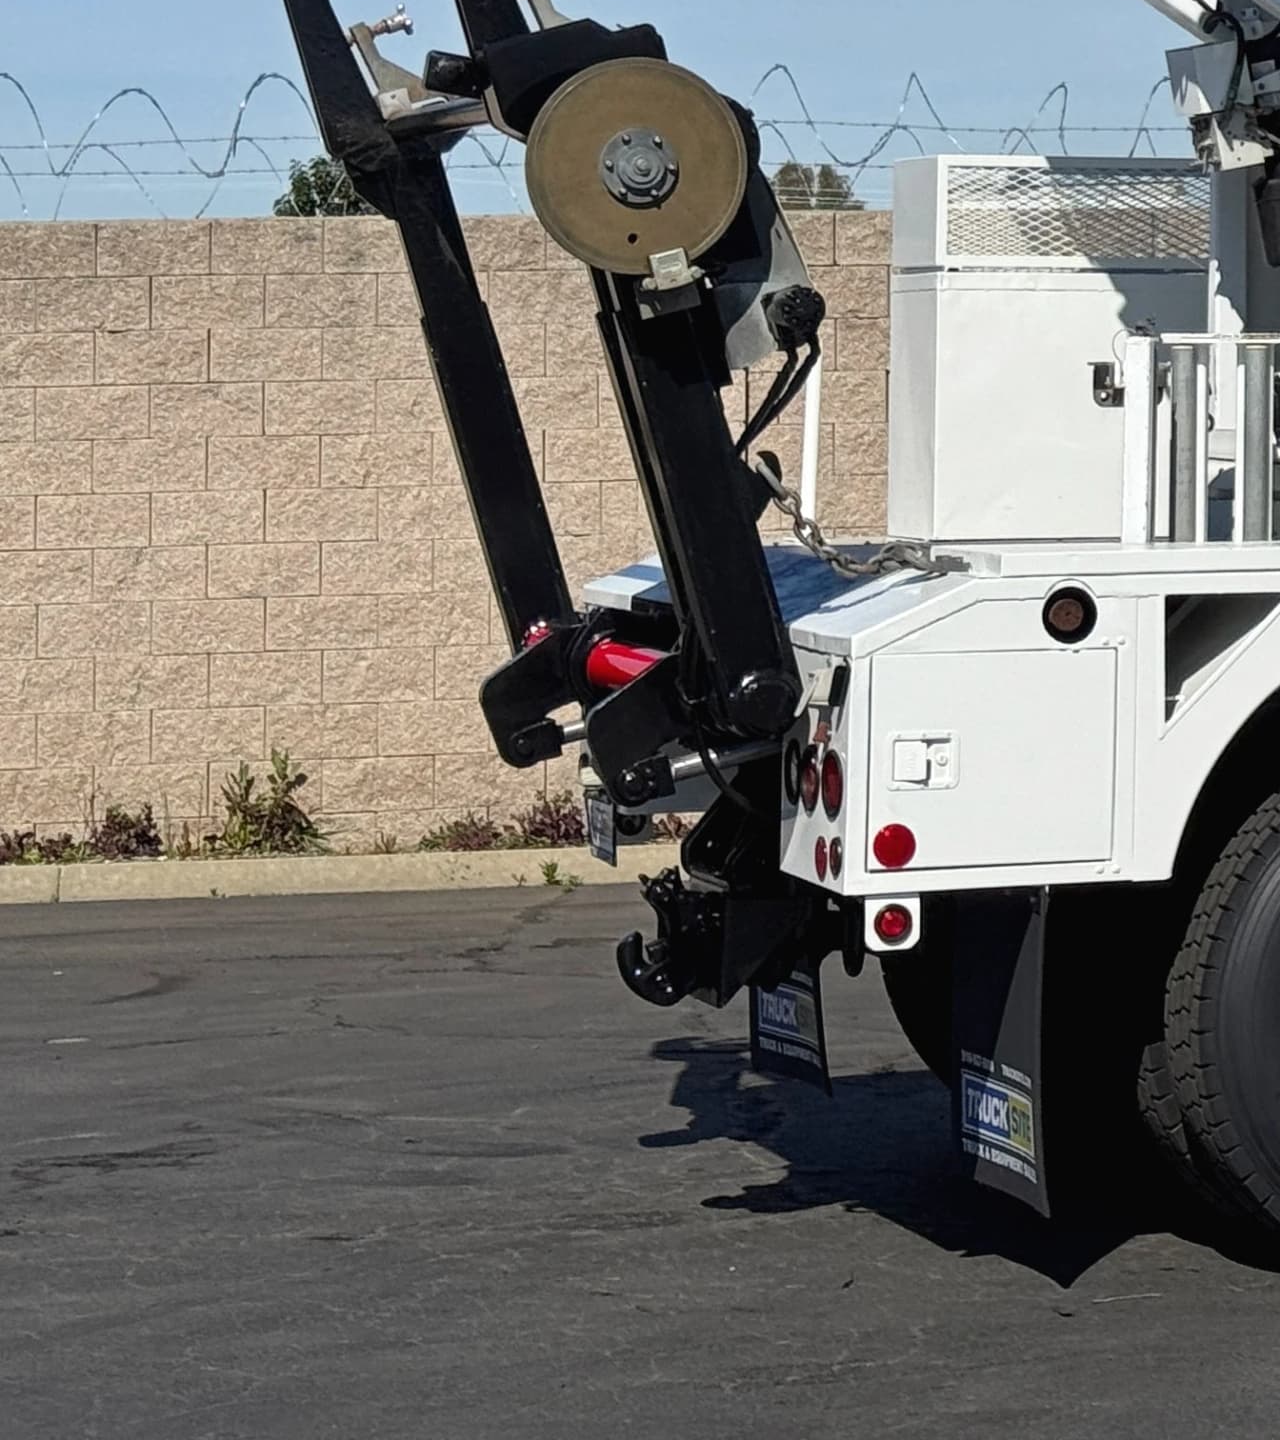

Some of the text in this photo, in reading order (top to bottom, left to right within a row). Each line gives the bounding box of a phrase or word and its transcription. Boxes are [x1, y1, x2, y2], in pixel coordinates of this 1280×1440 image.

[761, 991, 798, 1026] TRUCK
[967, 1087, 1032, 1143] TRUCK SITE
